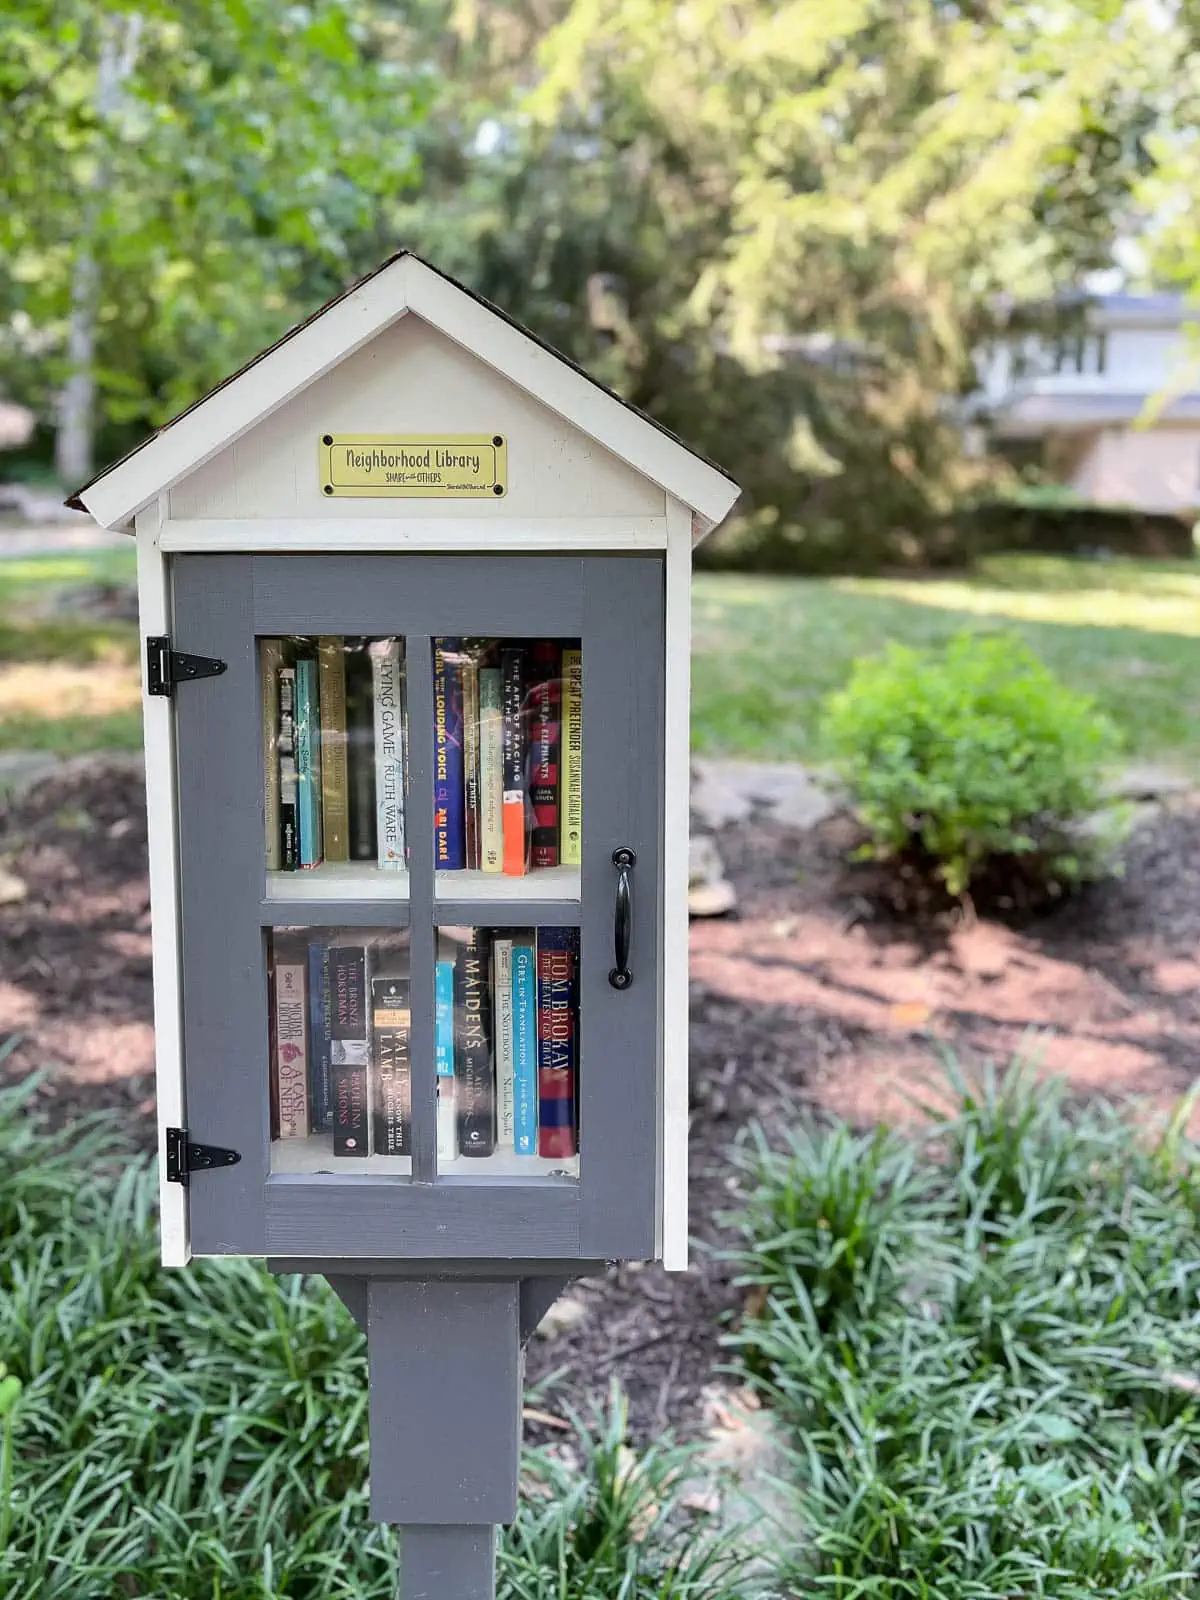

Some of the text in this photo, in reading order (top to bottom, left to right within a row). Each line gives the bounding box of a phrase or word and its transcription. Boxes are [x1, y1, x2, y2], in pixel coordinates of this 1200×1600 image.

[346, 449, 480, 474] Neighborhood Library
[385, 471, 405, 483] SHARE
[416, 472, 441, 483] OTHERS
[505, 680, 511, 692] IN
[380, 663, 395, 754] LYING GAME
[513, 713, 520, 728] OF
[568, 665, 582, 751] GREAT PRETENDER
[436, 695, 447, 781] LOUDING VOICE
[513, 734, 521, 782] RACING
[541, 728, 549, 780] ELEPHANTS
[384, 764, 397, 843] RUTH WARE
[568, 754, 581, 826] SUSANNAH CAHALAN
[438, 807, 449, 861] ABI DARÉ
[551, 952, 568, 992] TOM
[348, 961, 358, 1028] THE BRONZE
[464, 958, 481, 1050] MAIDENS
[542, 972, 551, 1018] GREATEST
[289, 1002, 302, 1037] MICHAEL
[501, 992, 511, 1062] THE NOTEBOOK
[280, 1065, 292, 1085] OF
[290, 1069, 303, 1081] A
[380, 1034, 393, 1081] LAMB
[281, 1087, 294, 1123] NEED
[292, 1082, 305, 1117] CASE
[387, 1116, 395, 1125] IS
[387, 1127, 395, 1151] TRUE
[395, 1126, 403, 1147] THIS
